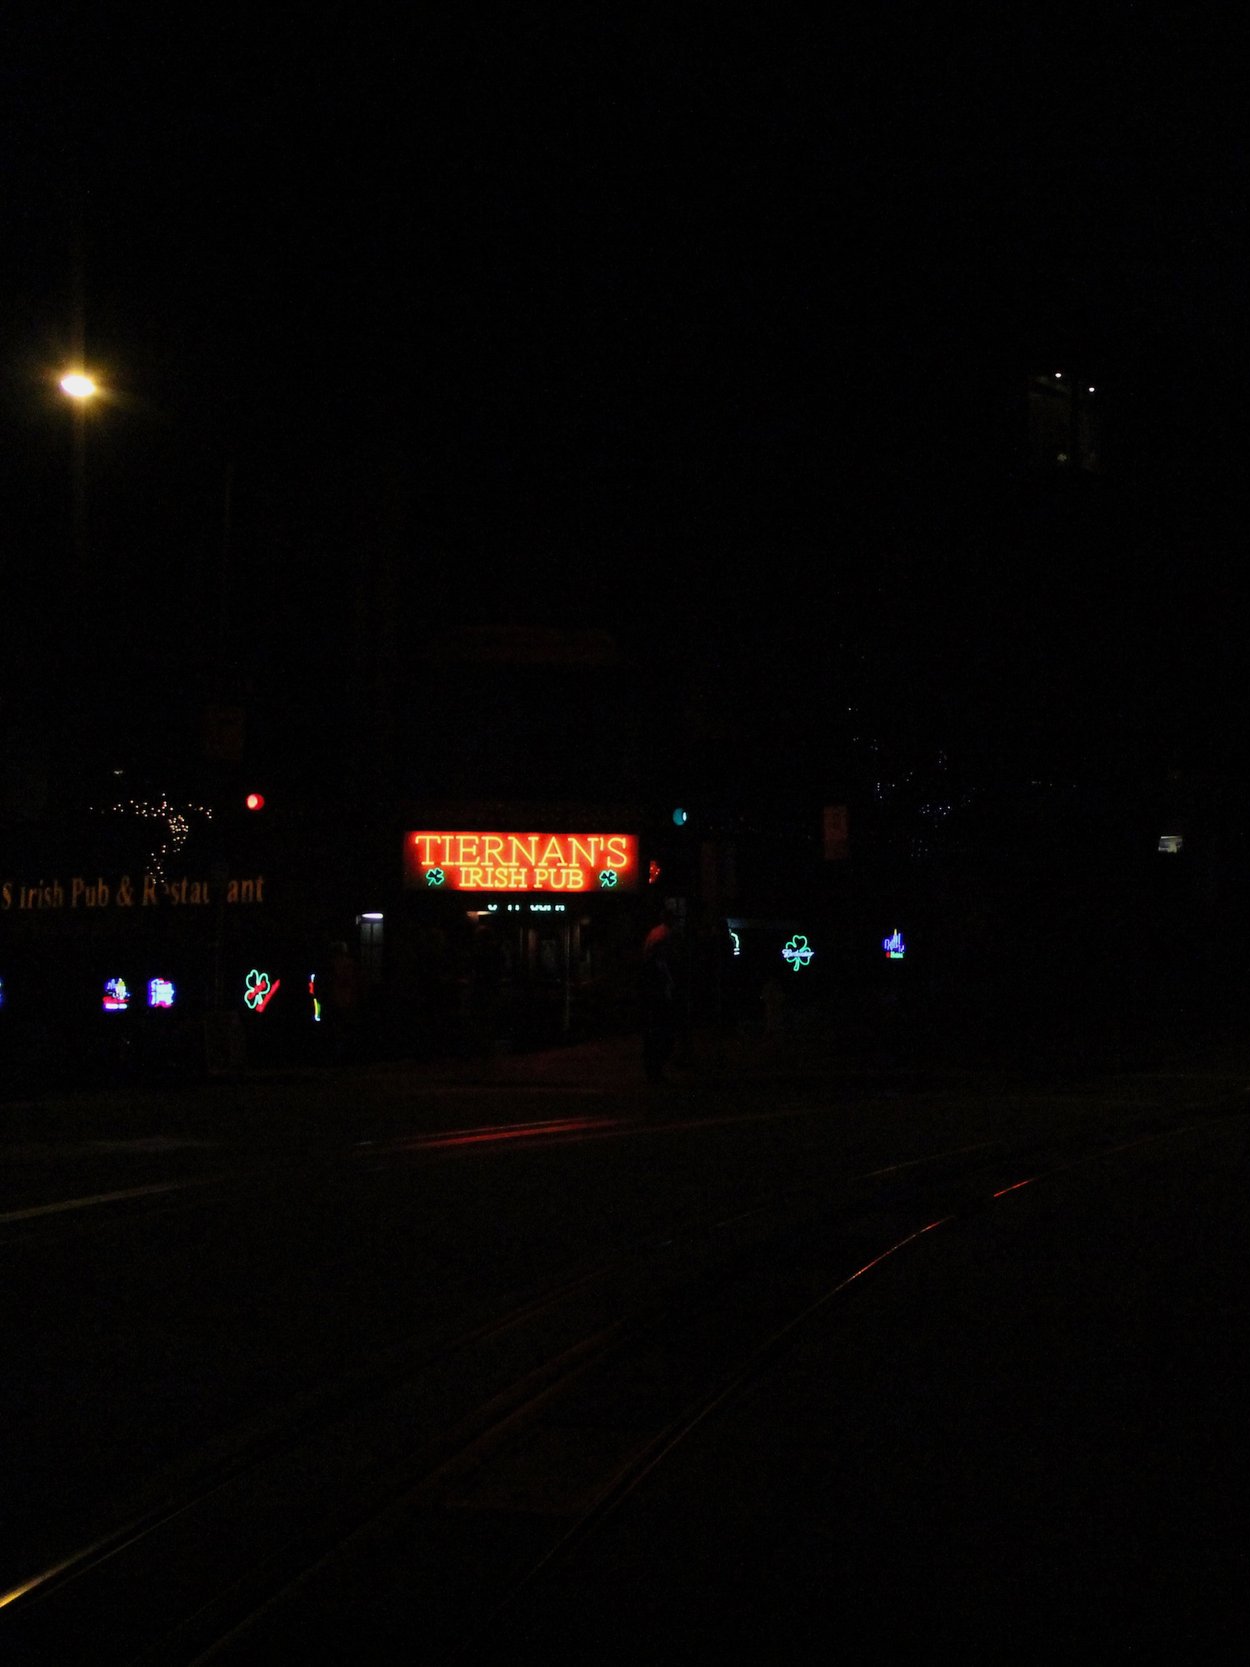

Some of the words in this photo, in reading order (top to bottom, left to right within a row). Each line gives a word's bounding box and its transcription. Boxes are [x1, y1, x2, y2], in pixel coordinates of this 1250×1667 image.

[415, 835, 628, 868] TIERNAN'S
[71, 877, 110, 908] Pub
[115, 875, 134, 907] &
[142, 876, 264, 906] Rstaant
[458, 867, 528, 888] IRISH
[533, 868, 584, 889] PUB
